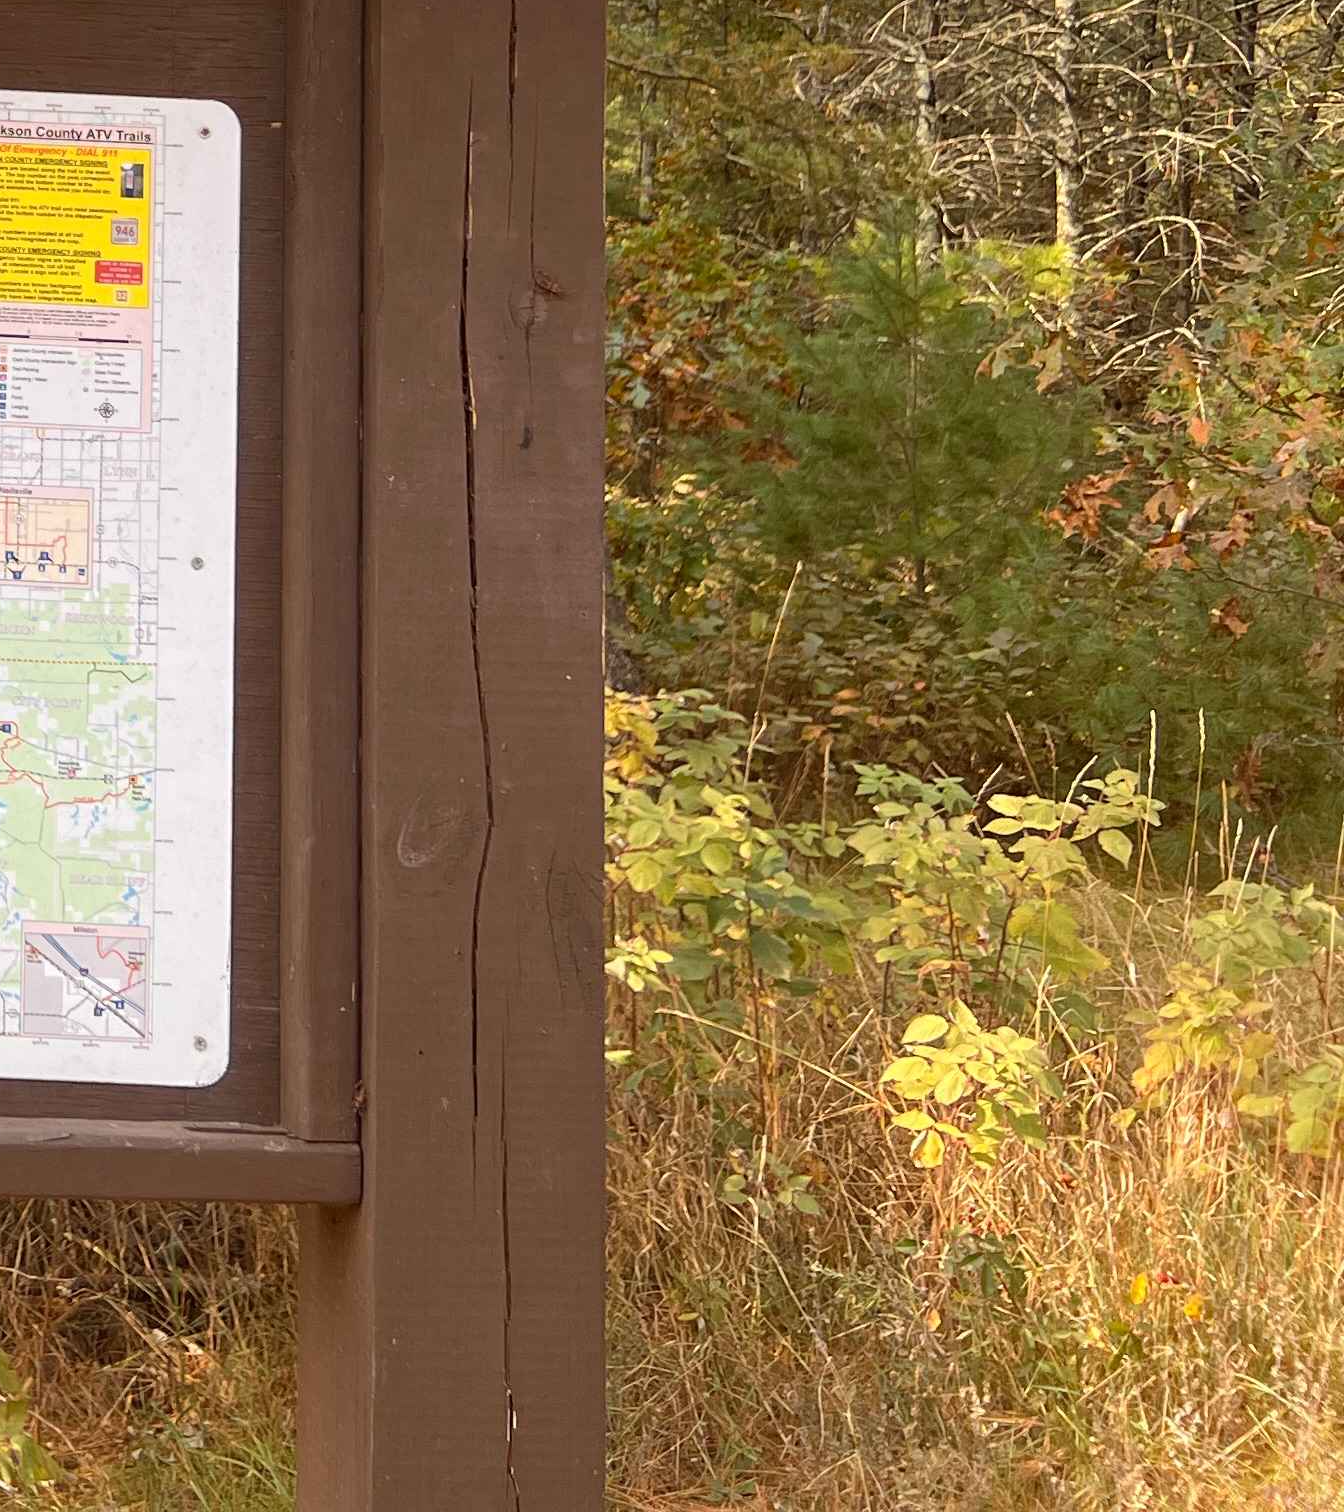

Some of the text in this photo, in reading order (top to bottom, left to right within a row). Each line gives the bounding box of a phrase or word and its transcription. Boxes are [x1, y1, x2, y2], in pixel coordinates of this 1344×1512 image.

[35, 126, 82, 141] County
[86, 128, 113, 140] ATV
[116, 130, 152, 143] Trails
[115, 225, 135, 238] 946
